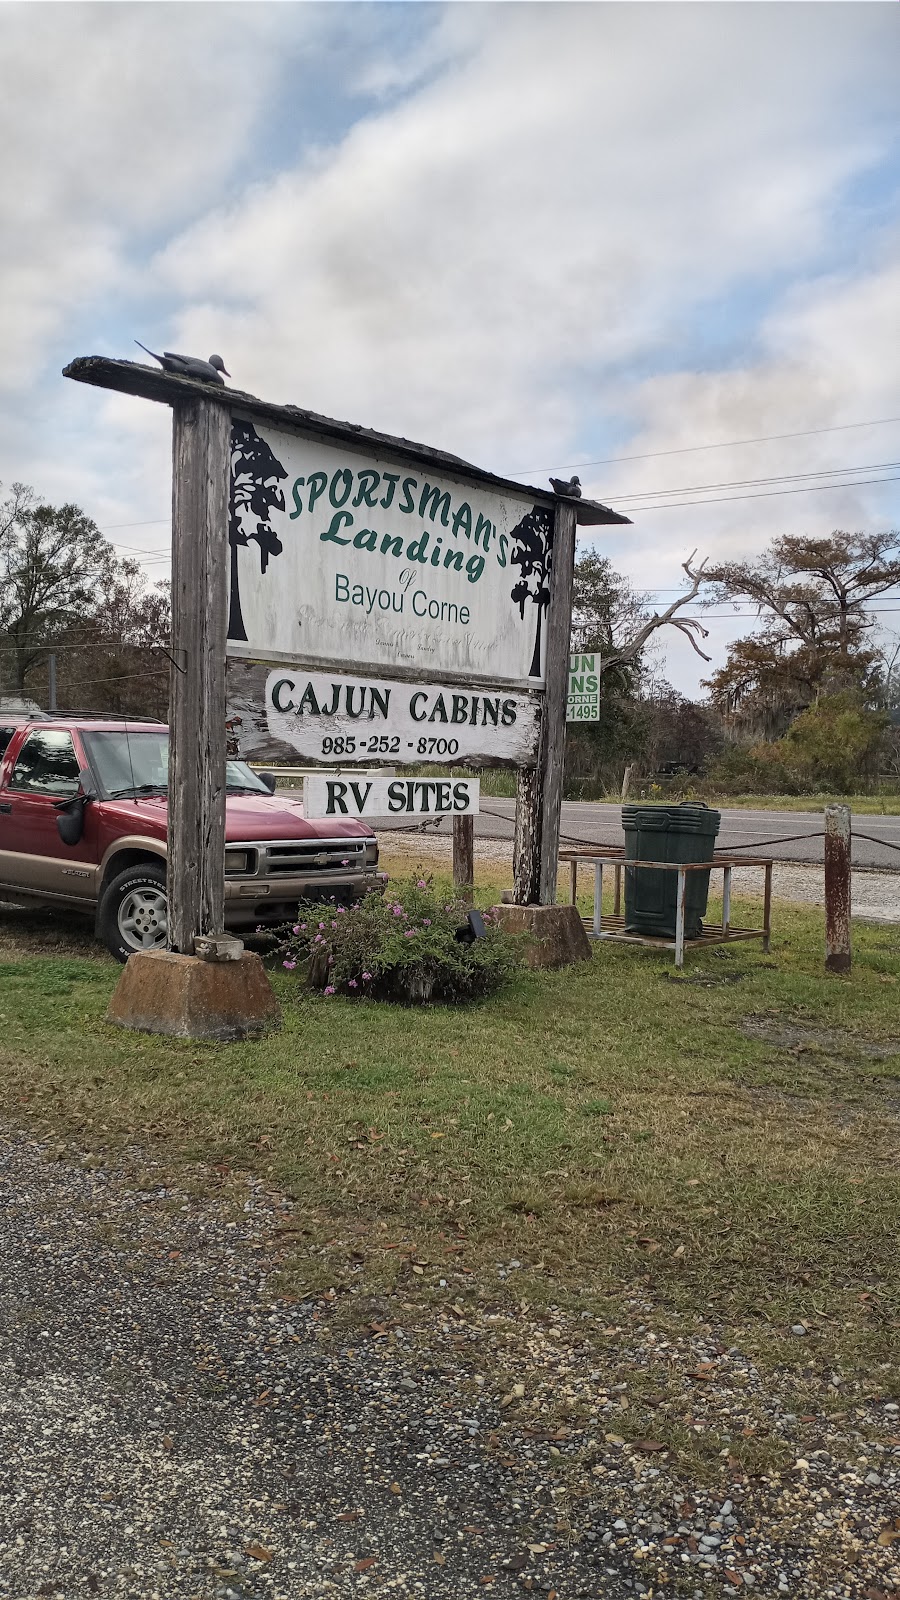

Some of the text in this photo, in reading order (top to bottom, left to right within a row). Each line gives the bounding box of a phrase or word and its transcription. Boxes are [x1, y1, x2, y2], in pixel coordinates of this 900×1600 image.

[289, 468, 509, 568] SPORTSMAN'S
[319, 510, 486, 583] Landing
[335, 573, 470, 625] Bayou Corne
[398, 567, 417, 592] Of
[271, 678, 517, 726] CAJUN CABINS
[570, 675, 598, 693] NS
[326, 781, 470, 814] RV SITES
